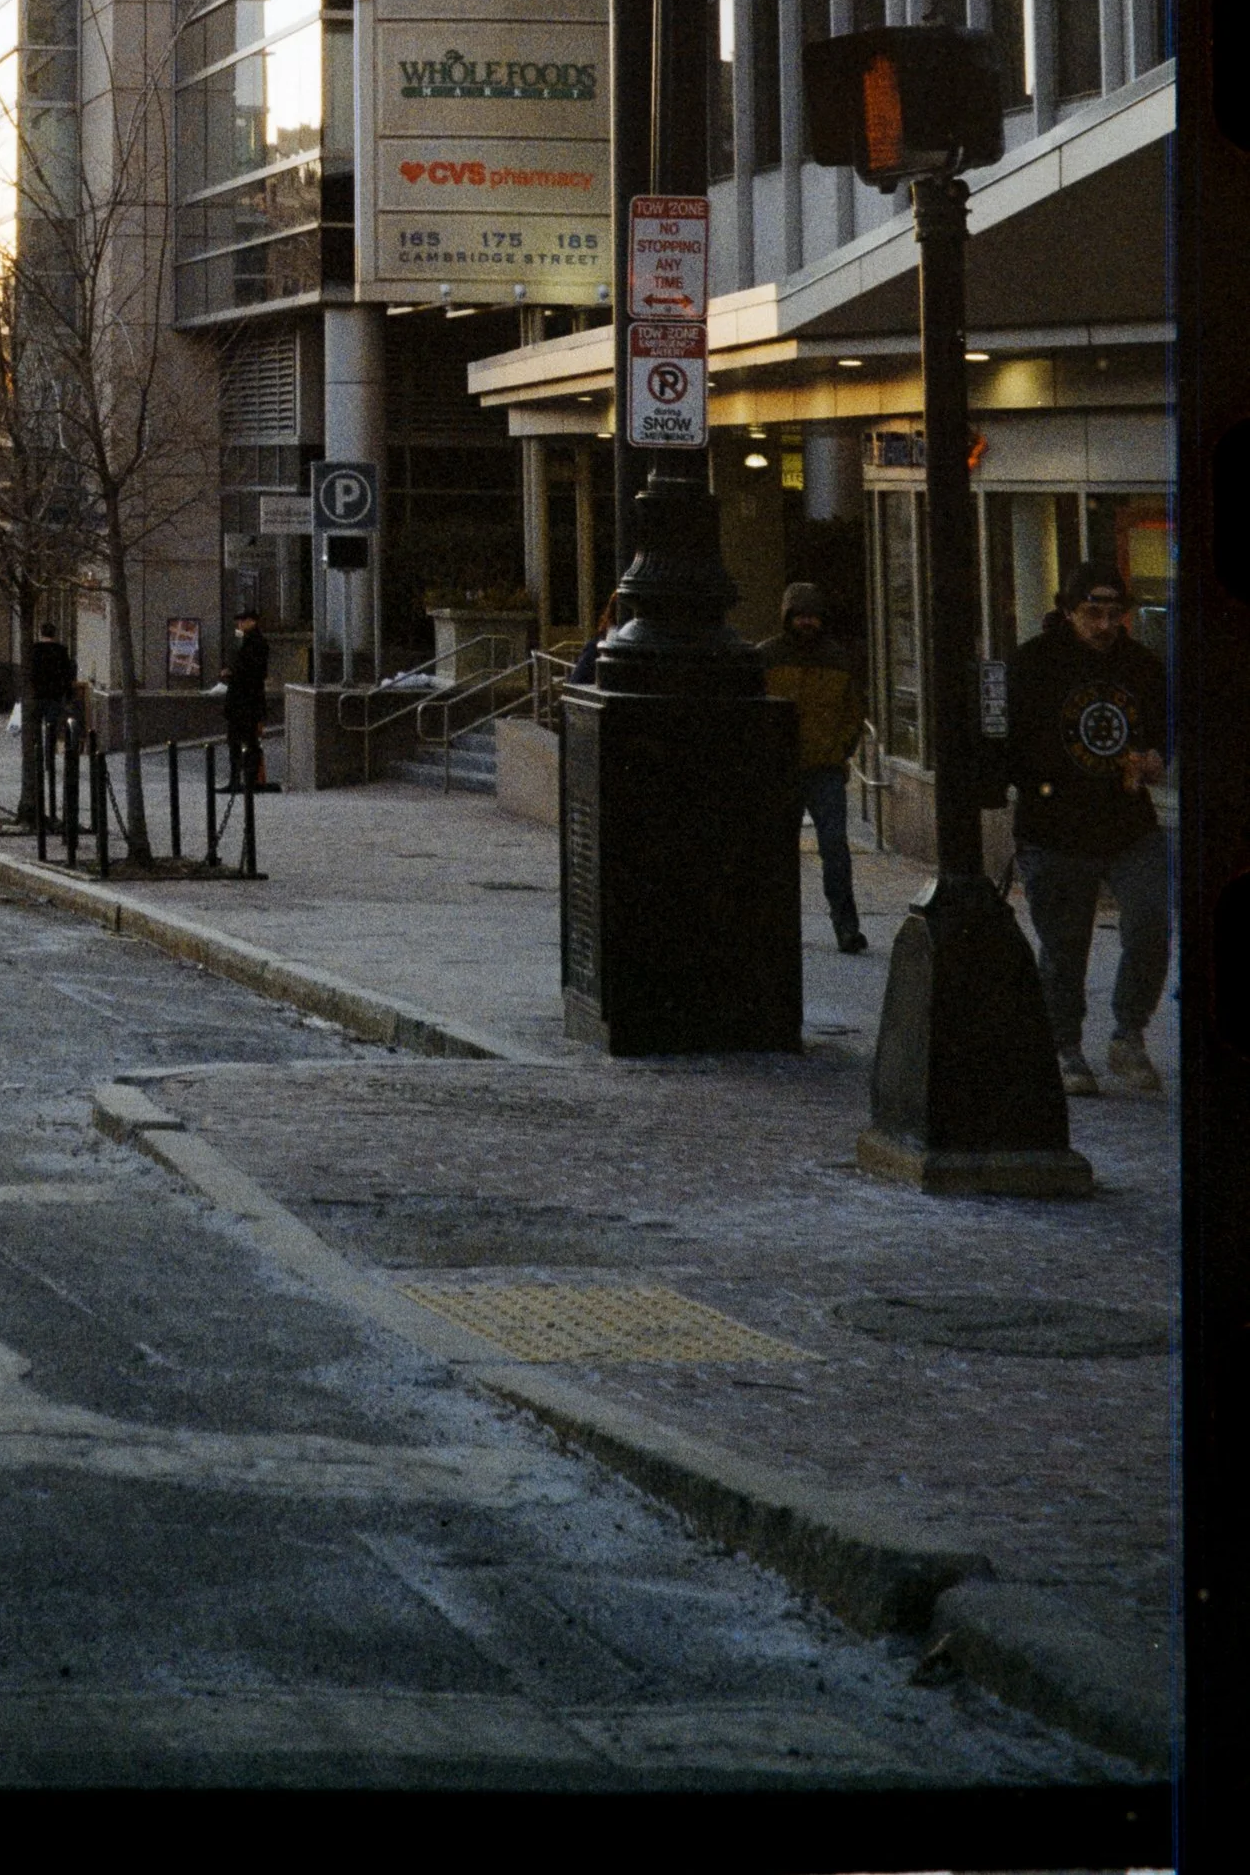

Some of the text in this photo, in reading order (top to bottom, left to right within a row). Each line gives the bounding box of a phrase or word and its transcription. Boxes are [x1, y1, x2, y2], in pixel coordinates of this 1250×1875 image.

[399, 59, 596, 88] WHOLE FOODS
[427, 161, 593, 192] CVS pharmacy
[637, 201, 706, 215] TOW ZONE
[659, 222, 680, 235] NO
[400, 231, 441, 247] 165
[481, 232, 523, 248] 175
[637, 239, 702, 254] STOPPING
[399, 251, 599, 266] CAMBRIDGE STREET
[655, 257, 683, 271] ANY
[654, 276, 685, 290] TIME
[638, 326, 700, 340] TOW ZONE
[642, 416, 693, 432] SNOW
[335, 478, 360, 515] P
